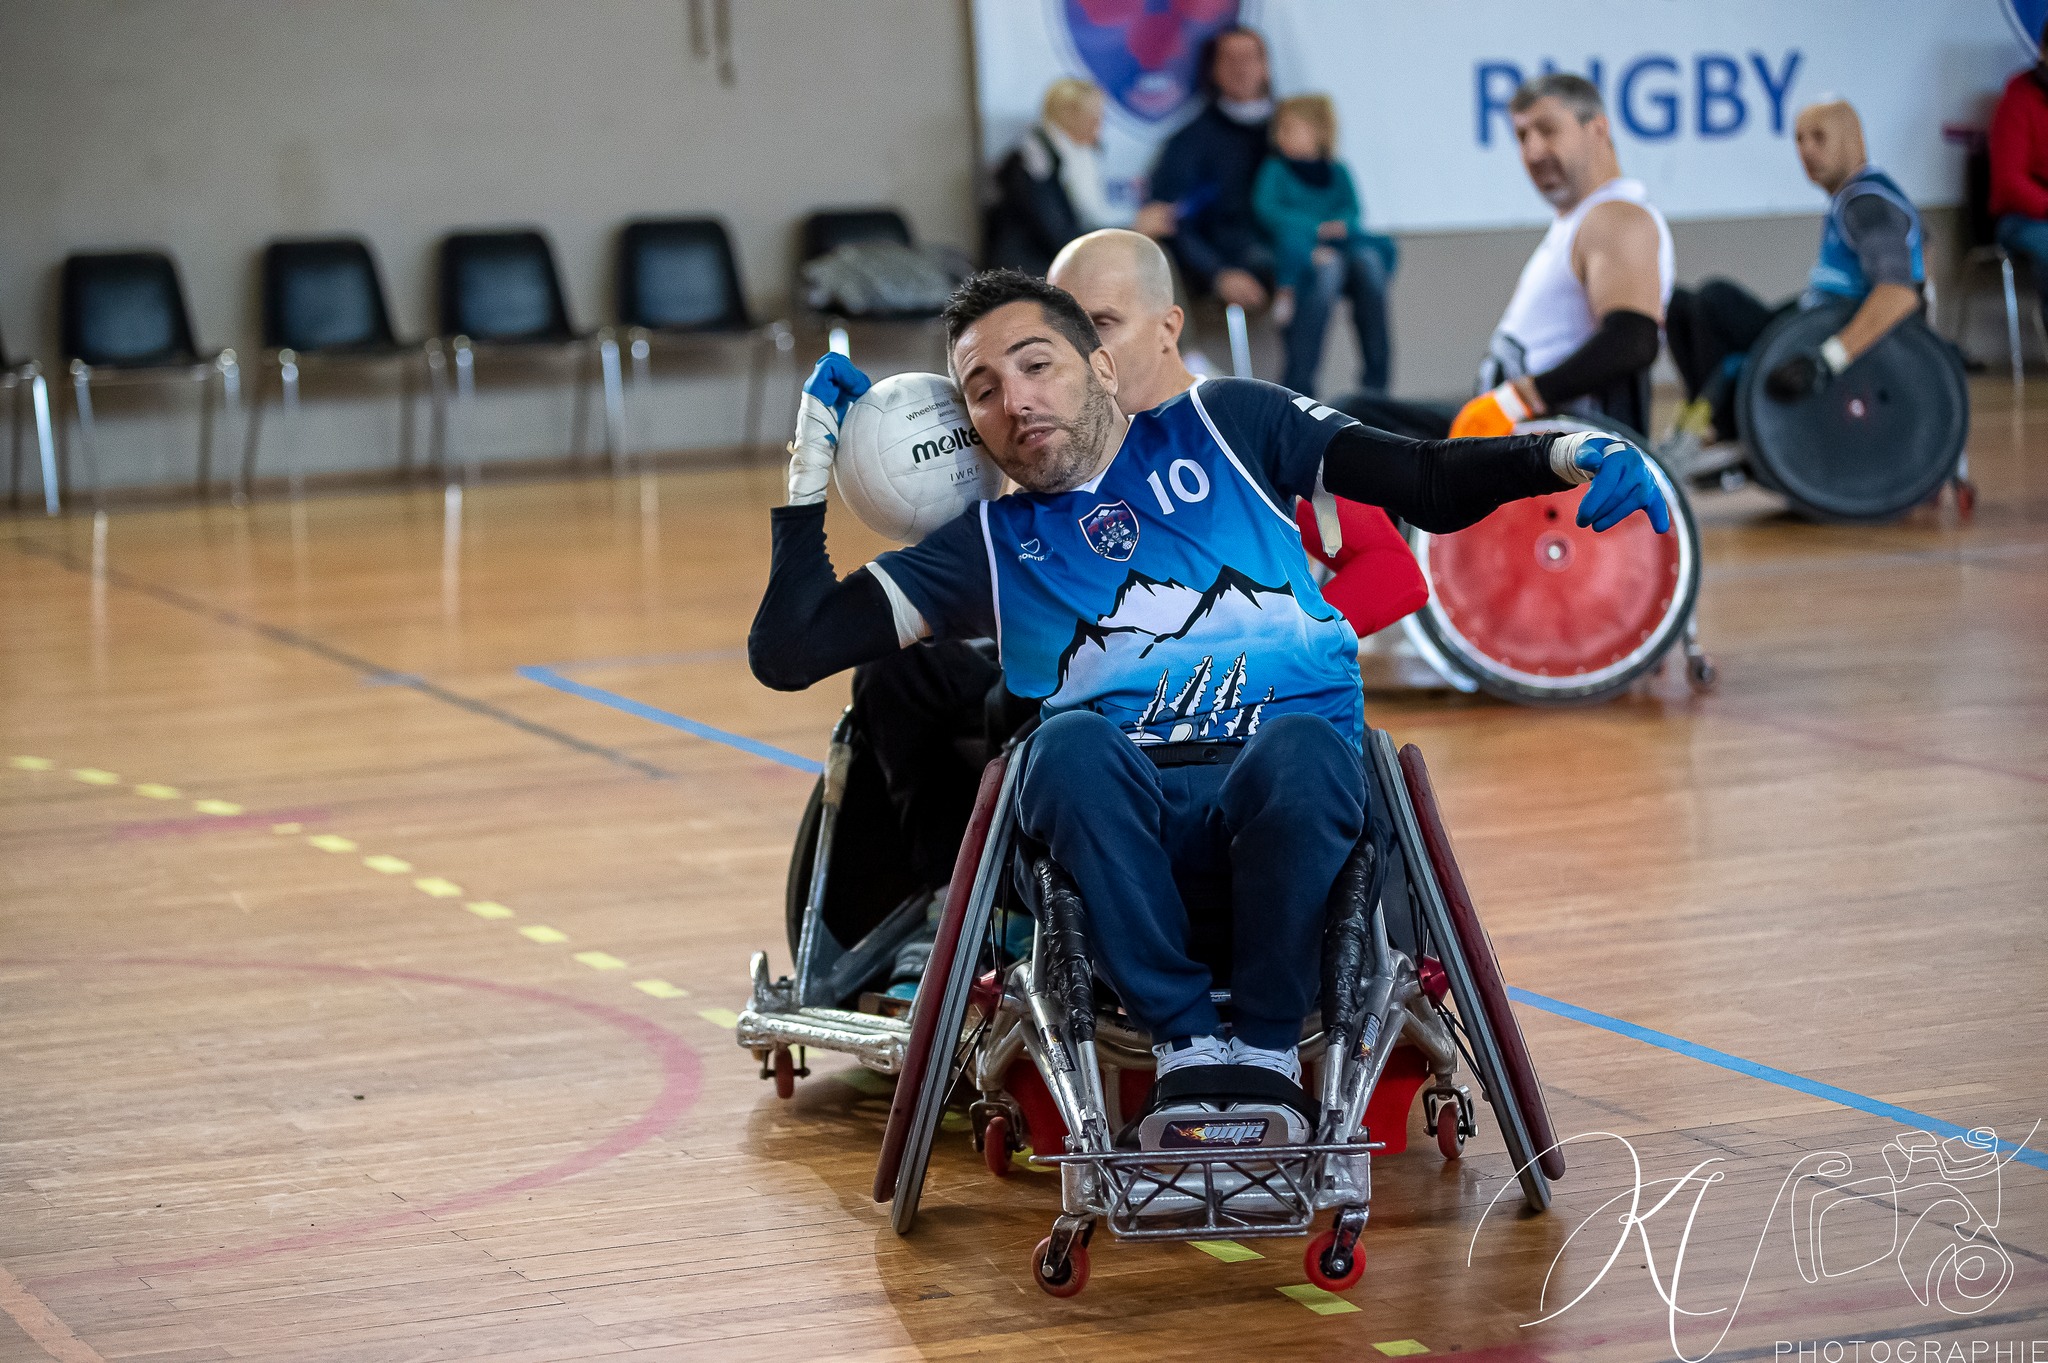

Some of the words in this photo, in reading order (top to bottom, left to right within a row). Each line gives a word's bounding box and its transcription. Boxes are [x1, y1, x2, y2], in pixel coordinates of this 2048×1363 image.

[1474, 50, 1802, 147] RGBY
[905, 400, 951, 421] Wheelchair
[911, 427, 983, 464] molte
[1146, 458, 1211, 515] 10
